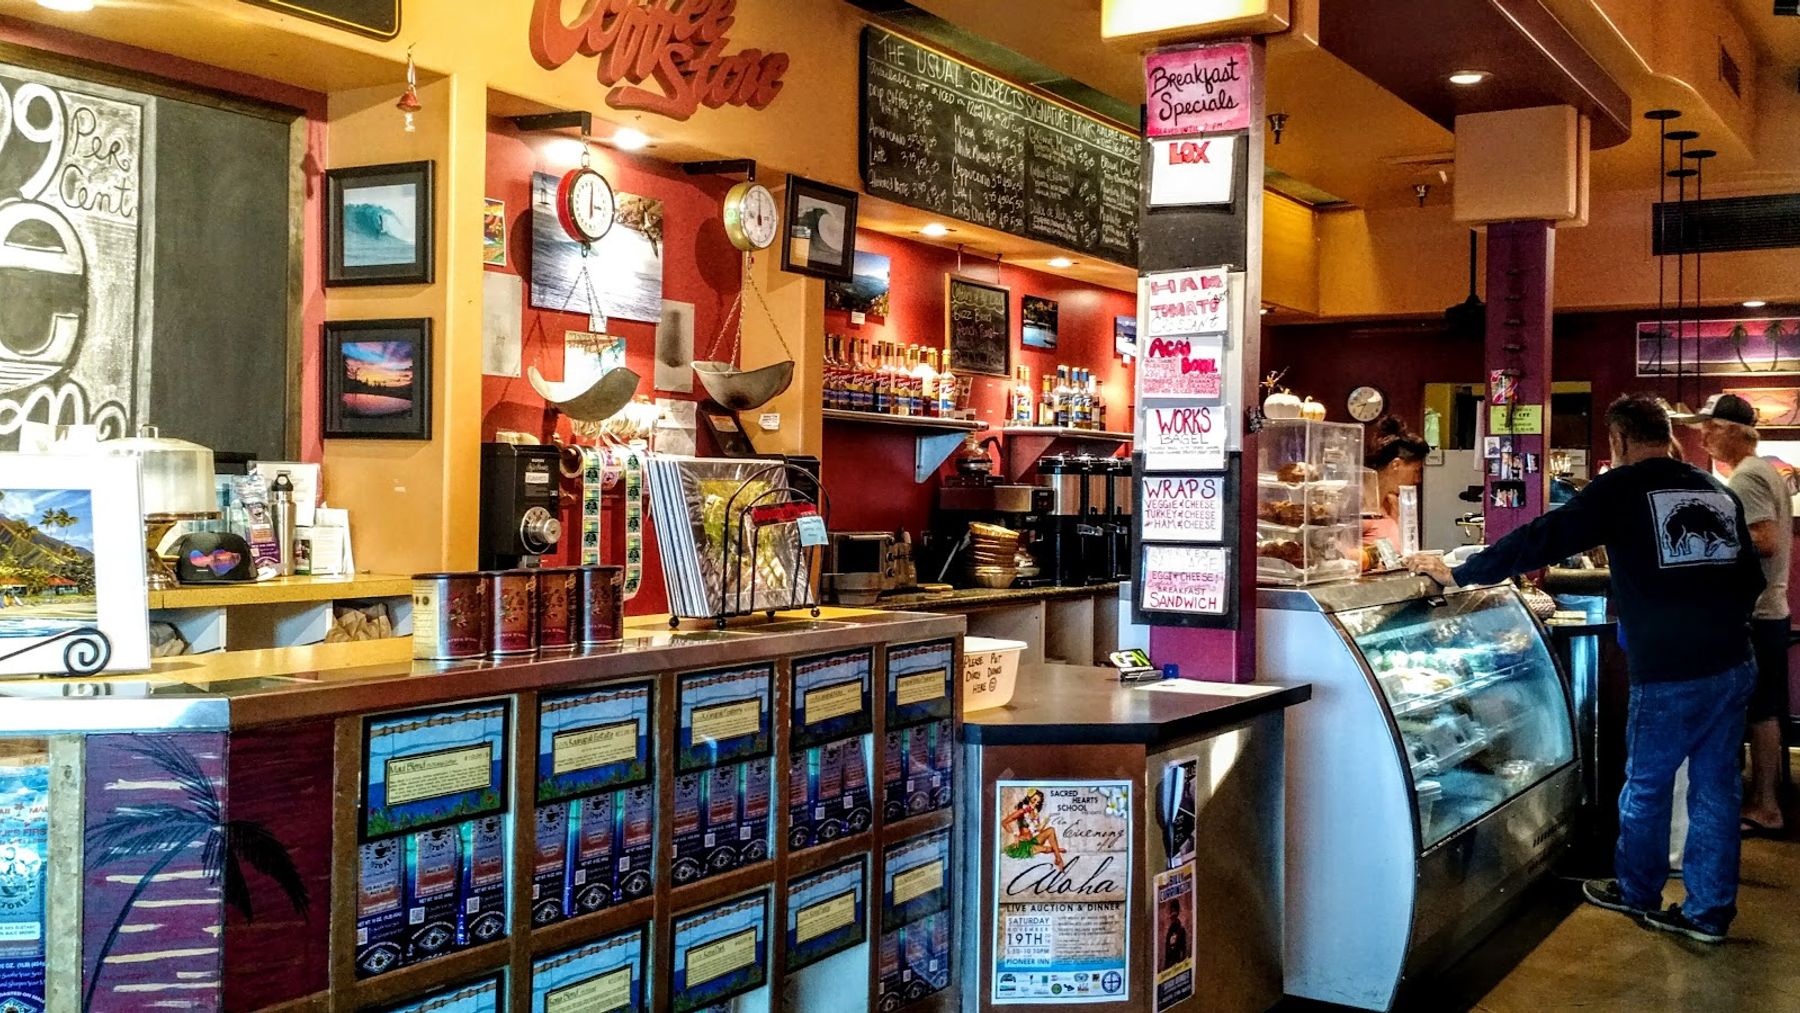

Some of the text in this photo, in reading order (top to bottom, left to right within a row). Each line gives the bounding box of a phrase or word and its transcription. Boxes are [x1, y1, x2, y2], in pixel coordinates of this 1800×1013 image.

[605, 37, 790, 121] Store
[878, 33, 905, 67] THE
[916, 49, 964, 88] USUAL
[970, 70, 1025, 110] SUSPECTS
[1026, 94, 1069, 131] SIGNATURE
[1149, 56, 1241, 98] Breakfast
[1159, 88, 1240, 126] Specials
[1168, 140, 1211, 166] LOX
[59, 163, 134, 219] Cent
[1150, 275, 1223, 296] HAM
[1150, 299, 1220, 318] TOMATO
[1155, 406, 1212, 434] WORKS
[1144, 478, 1216, 499] WRAPS
[1145, 500, 1179, 509] VEGGIE
[1184, 500, 1216, 509] CHEESE
[1145, 510, 1178, 519] TURKEY
[1184, 510, 1216, 520] CHEESE
[1153, 520, 1177, 529] HAM
[1183, 520, 1216, 530] CHEESE
[1150, 592, 1217, 610] SANDWICH
[1057, 804, 1087, 812] SCHOOL
[1006, 855, 1119, 896] Aloha
[1007, 904, 1026, 912] LIVE
[1030, 904, 1073, 912] AUCTION
[1087, 903, 1120, 911] DINNER
[1007, 933, 1043, 945] 19TH
